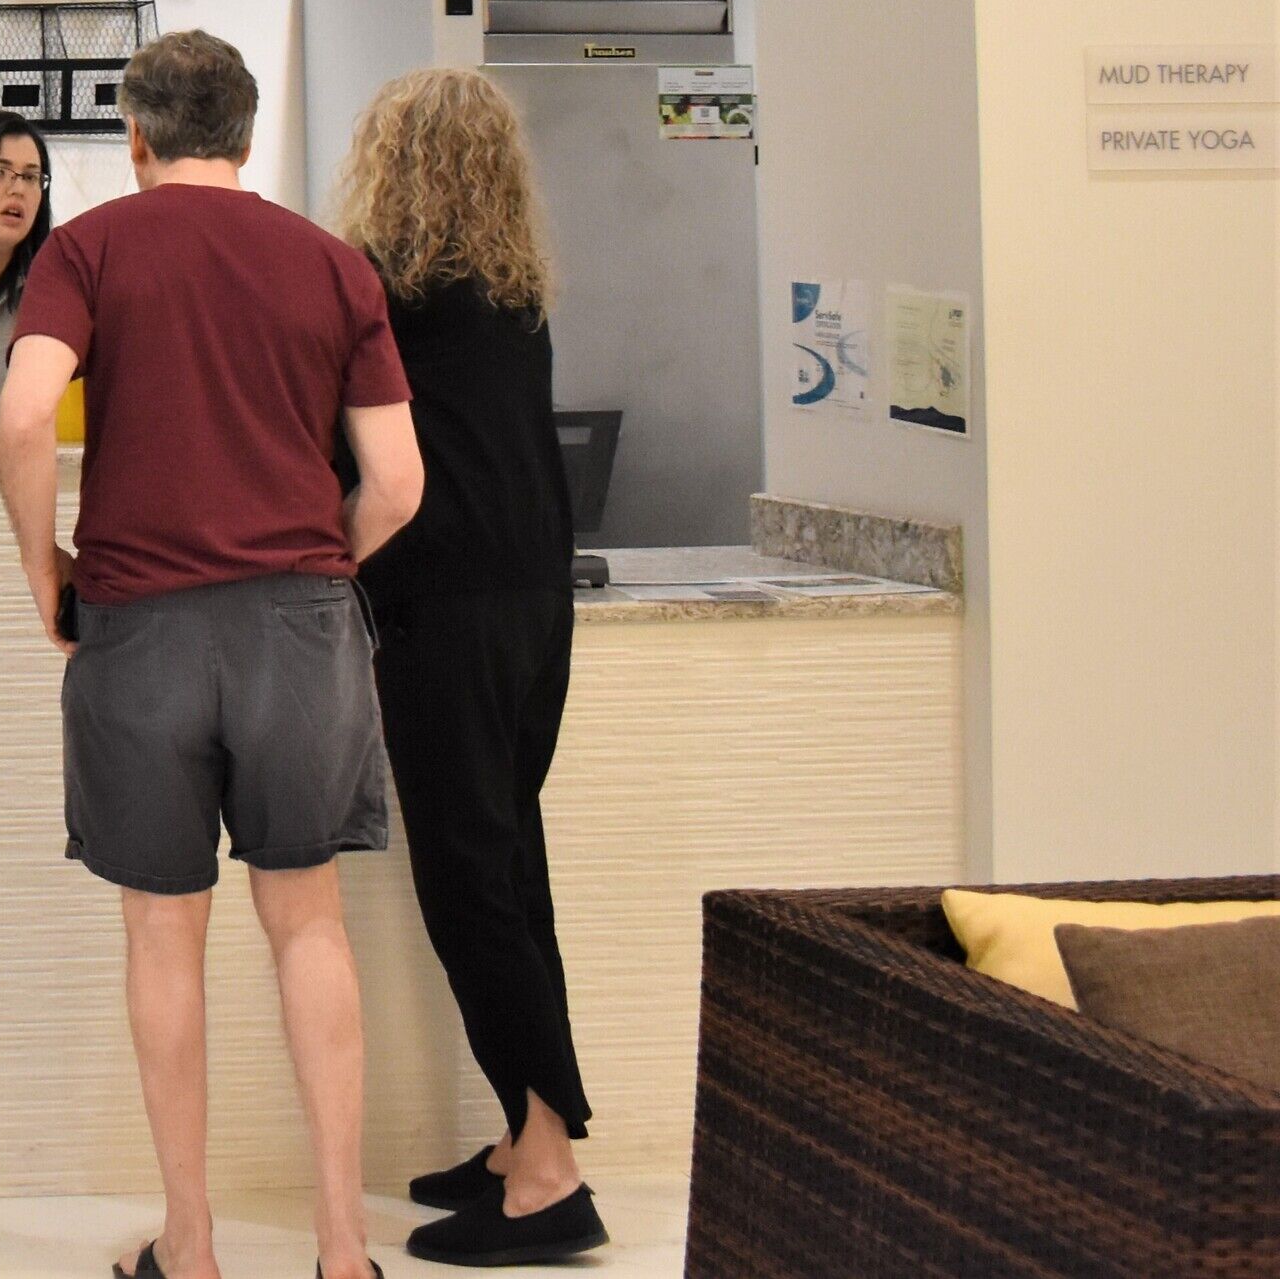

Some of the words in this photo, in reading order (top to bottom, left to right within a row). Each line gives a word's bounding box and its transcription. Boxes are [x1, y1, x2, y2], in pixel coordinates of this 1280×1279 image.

[1099, 64, 1150, 84] MUD
[1157, 64, 1249, 84] THERAPY
[1101, 130, 1180, 150] PRIVATE
[1188, 129, 1255, 150] YOGA
